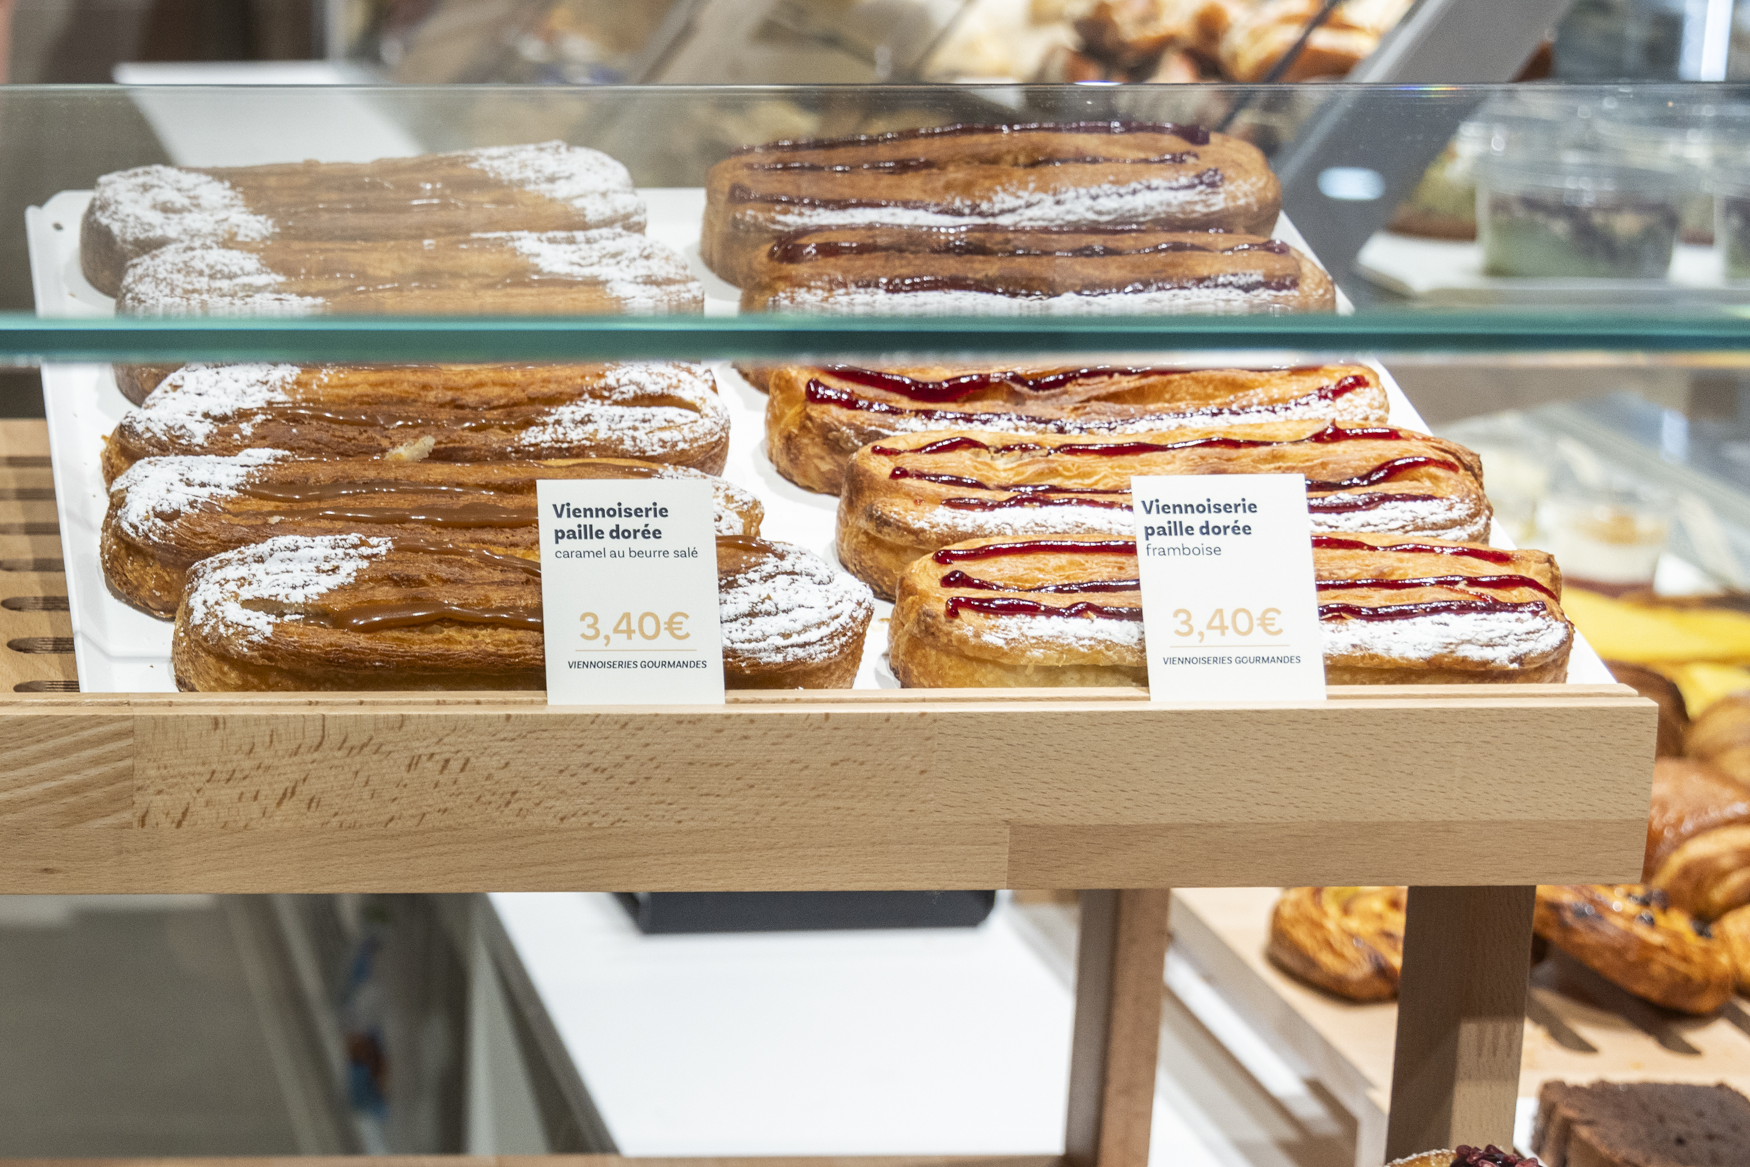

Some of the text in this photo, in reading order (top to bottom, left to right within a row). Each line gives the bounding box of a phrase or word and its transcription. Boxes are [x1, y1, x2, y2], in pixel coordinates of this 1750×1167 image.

[552, 502, 669, 519] Viennoiserie
[1141, 498, 1258, 515] Viennoiserie
[554, 524, 663, 544] paille dorée
[1144, 520, 1252, 541] paille dorée
[554, 547, 699, 559] caramel au beurre salé
[1146, 543, 1222, 557] framboise
[579, 611, 691, 647] 3,40€
[1172, 607, 1284, 644] 3,40€
[568, 660, 707, 669] VIENNOISERIES GOURMANDES
[1162, 655, 1301, 665] VIENNOISERIES GOURMANDES
